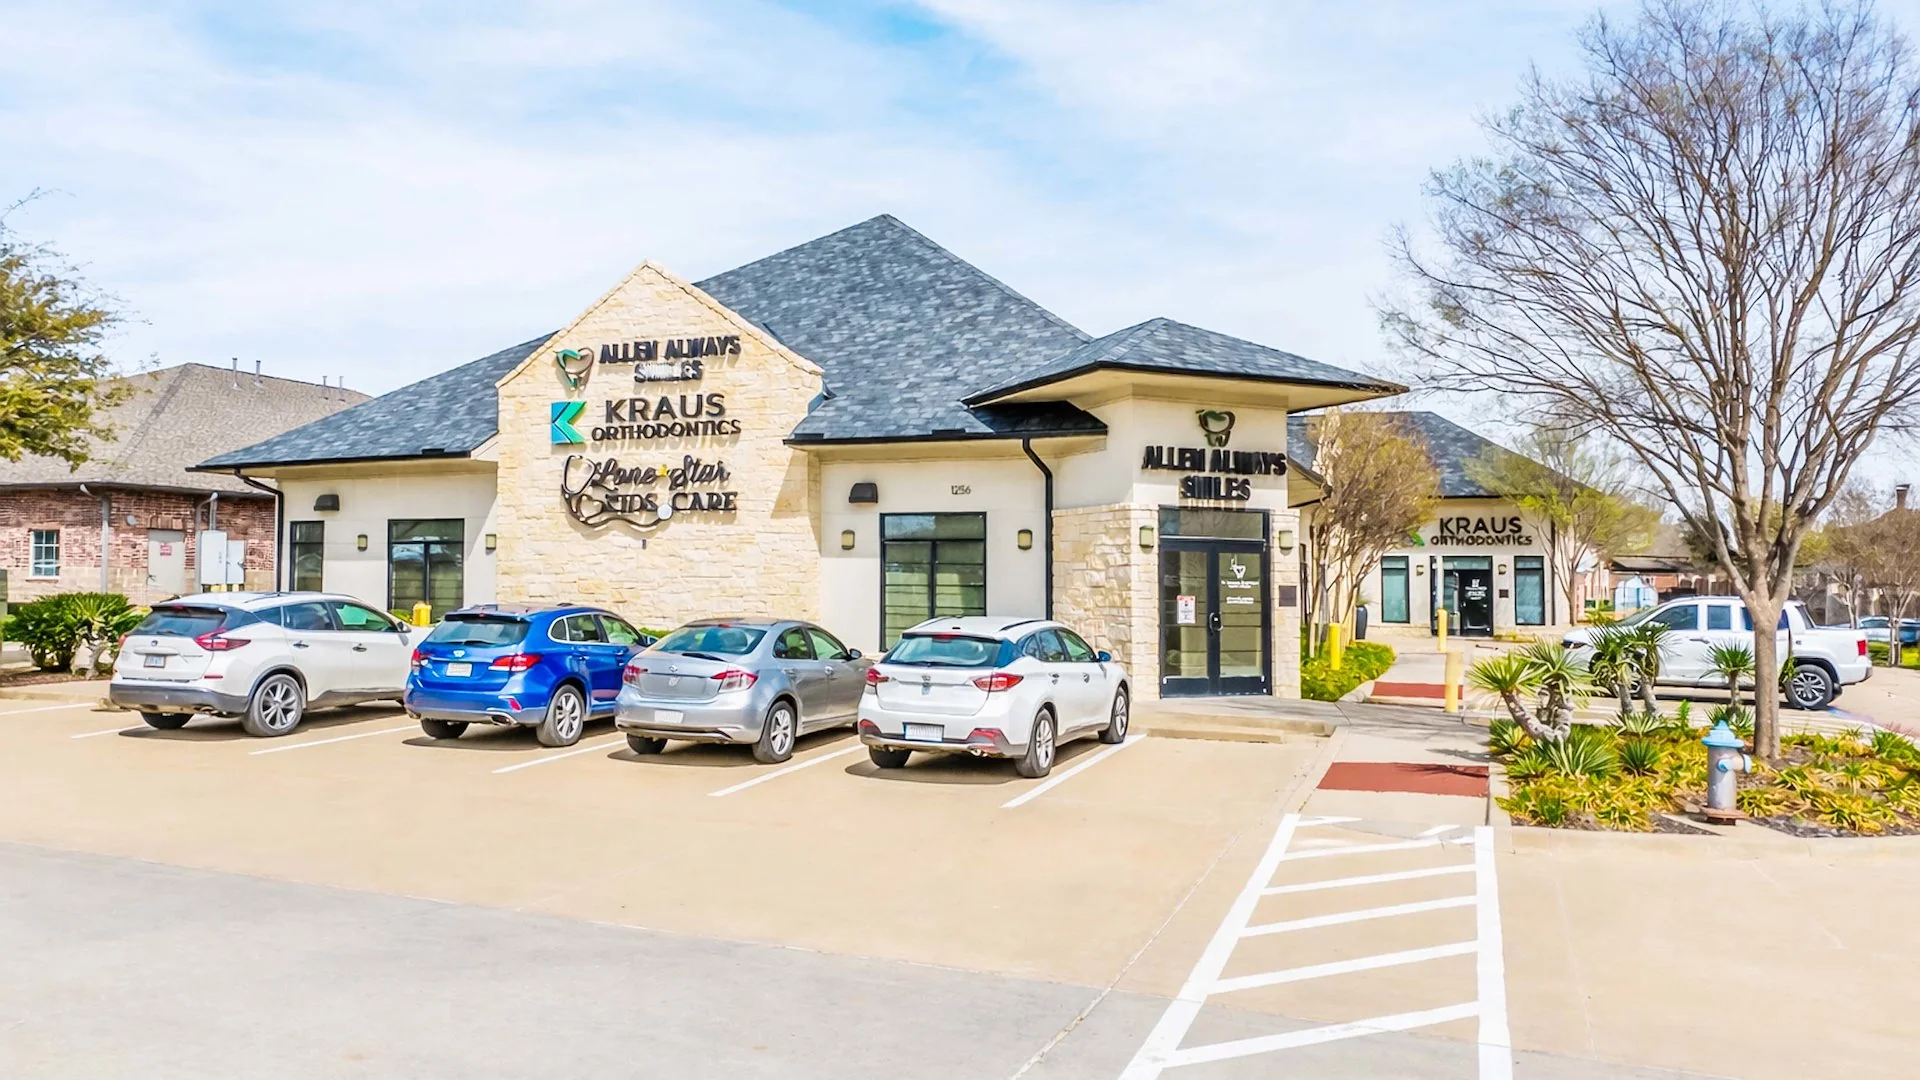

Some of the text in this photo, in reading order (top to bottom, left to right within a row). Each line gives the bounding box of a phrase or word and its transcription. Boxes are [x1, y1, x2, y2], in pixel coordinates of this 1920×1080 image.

[599, 335, 741, 363] ALLEN ALWAYS
[605, 393, 725, 424] KRAUS
[591, 419, 741, 442] ORTHODONTICS
[1142, 446, 1287, 476] ALLEN ALWAYS
[589, 455, 731, 493] Lone Star
[951, 484, 972, 495] 1256
[1180, 475, 1251, 501] SMILES
[672, 491, 738, 511] CARE
[1440, 517, 1522, 535] KRAUS
[1431, 534, 1533, 546] ORTHODONTICS
